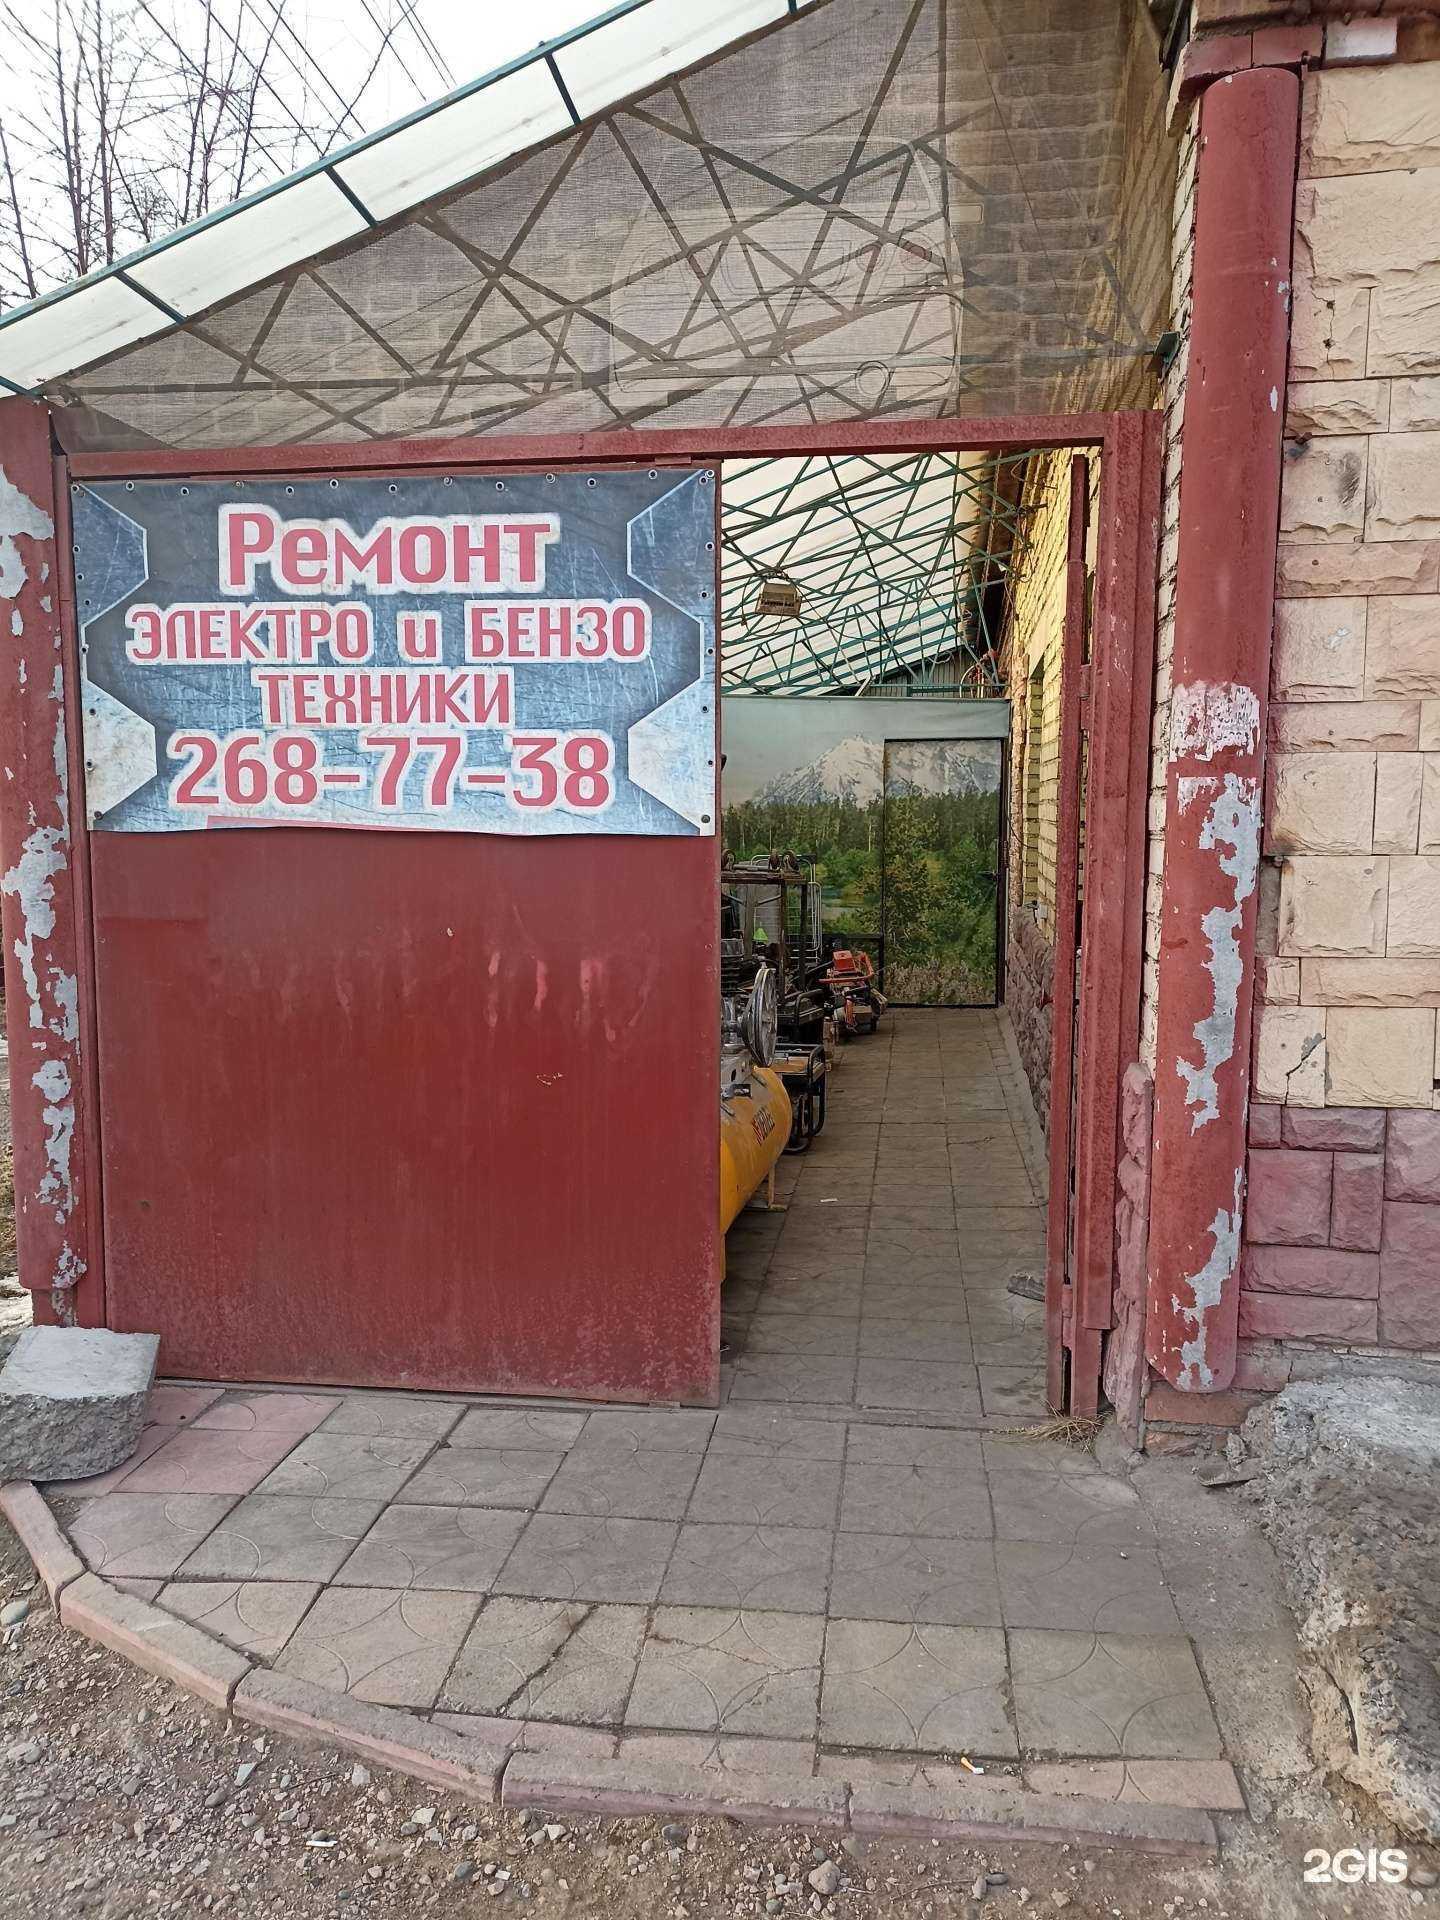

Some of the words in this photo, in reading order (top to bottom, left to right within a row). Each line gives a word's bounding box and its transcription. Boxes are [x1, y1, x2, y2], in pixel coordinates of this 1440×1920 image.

[226, 510, 553, 588] Ремонт
[129, 605, 371, 662] ЭЛЕКТРО
[469, 604, 649, 660] БЕНЗО
[256, 672, 512, 726] ТЕХНИКИ
[173, 734, 613, 809] 268-77-38
